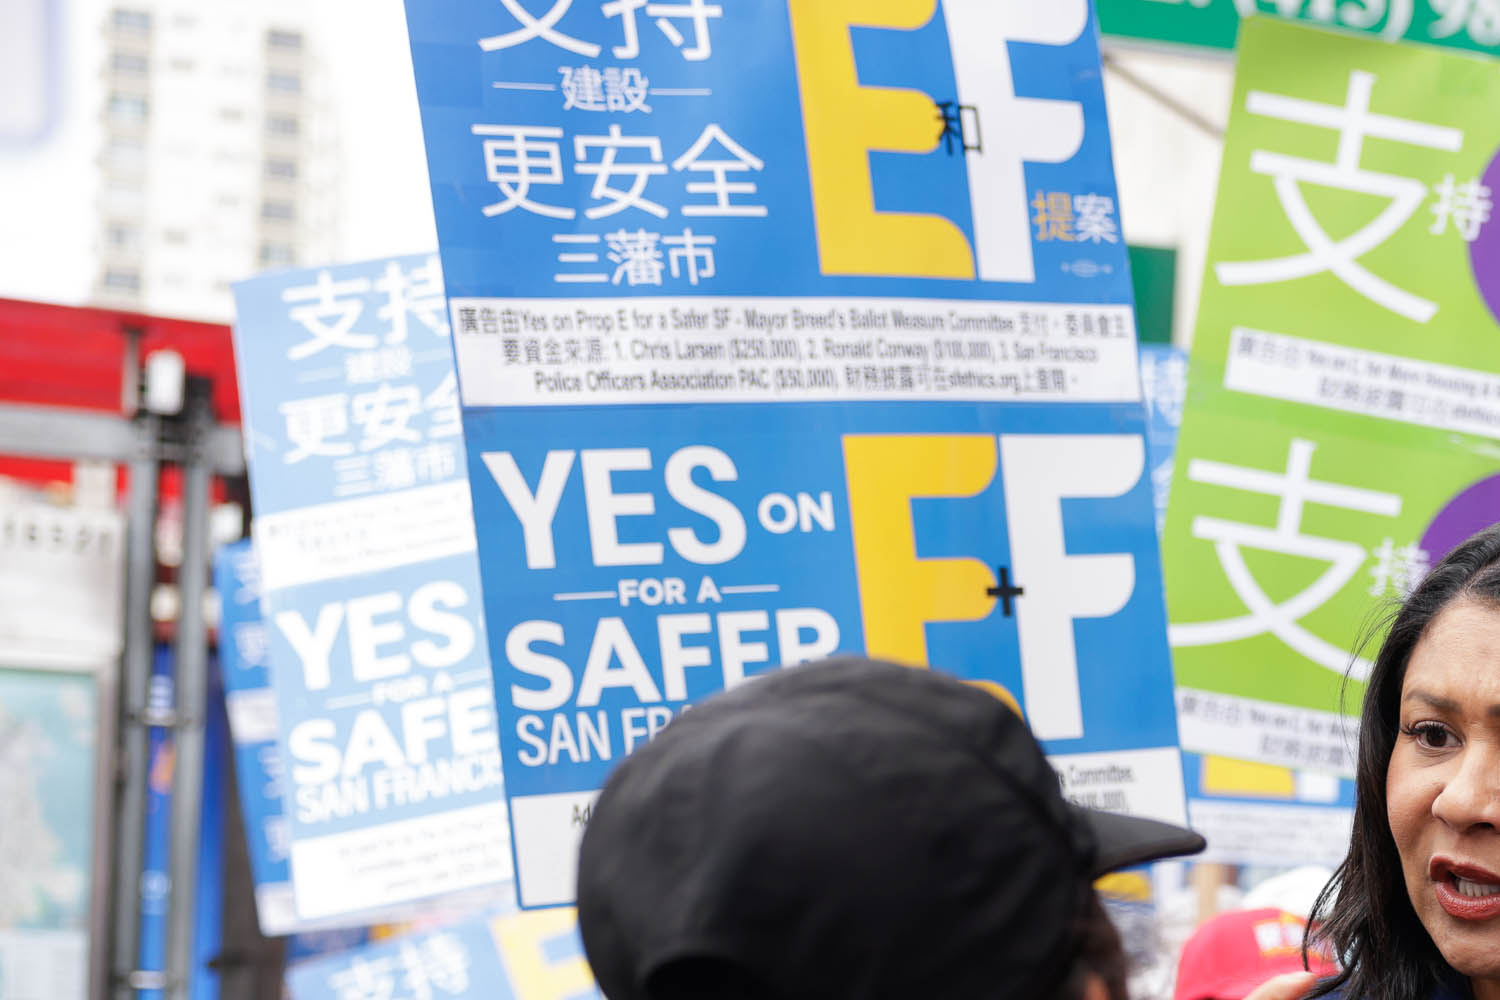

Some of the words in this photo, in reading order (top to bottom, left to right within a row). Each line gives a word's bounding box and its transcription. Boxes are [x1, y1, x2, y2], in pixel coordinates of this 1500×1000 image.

[557, 65, 653, 115] 建設
[470, 123, 768, 220] 更安全
[1031, 191, 1121, 246] 提案
[553, 228, 717, 288] 三藩市
[481, 445, 747, 570] YES
[757, 490, 836, 534] ON
[618, 577, 687, 607] FOR
[696, 575, 722, 603] A
[999, 434, 1145, 742] F
[275, 580, 477, 692] YES
[516, 711, 611, 767] SAN
